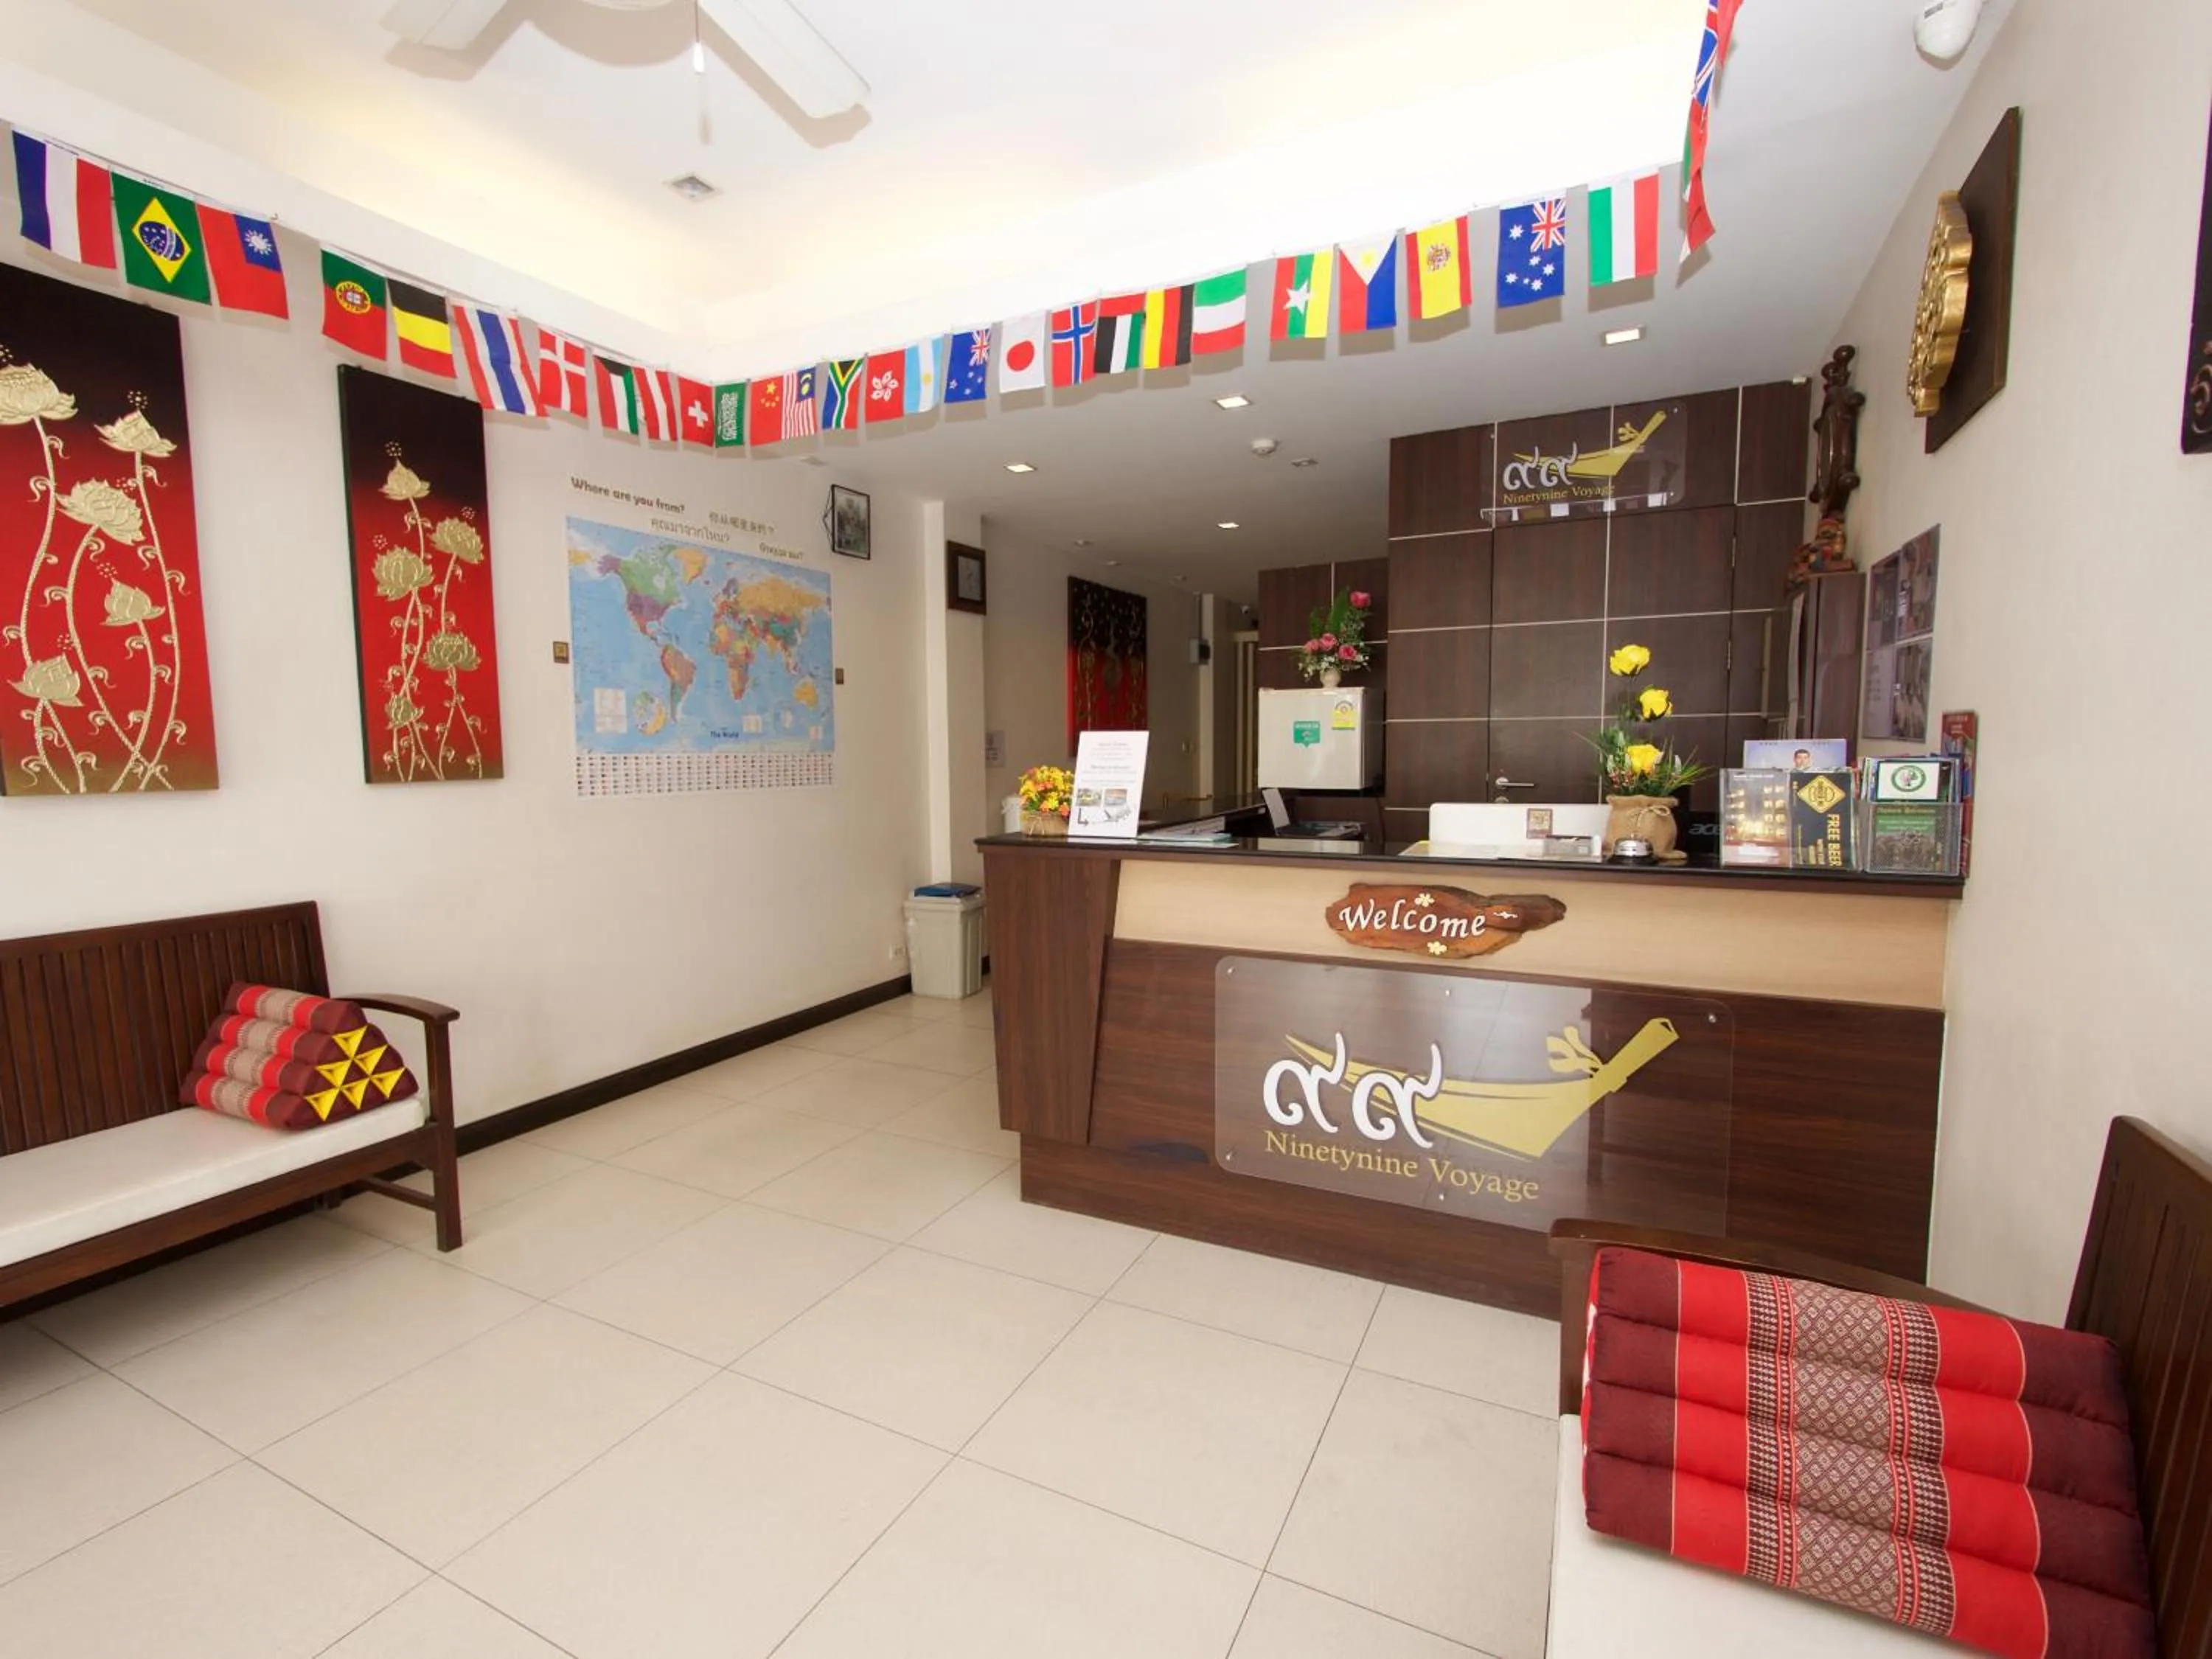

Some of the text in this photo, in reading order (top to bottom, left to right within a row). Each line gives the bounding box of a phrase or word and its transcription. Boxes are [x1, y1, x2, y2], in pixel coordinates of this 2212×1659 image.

[571, 476, 686, 513] Where are you from?
[1503, 484, 1615, 504] Ninetynine Voyage
[1827, 814, 1843, 866] FREE BEER
[1338, 898, 1486, 939] Welcome
[1265, 1130, 1540, 1203] Ninetynine Voyage
